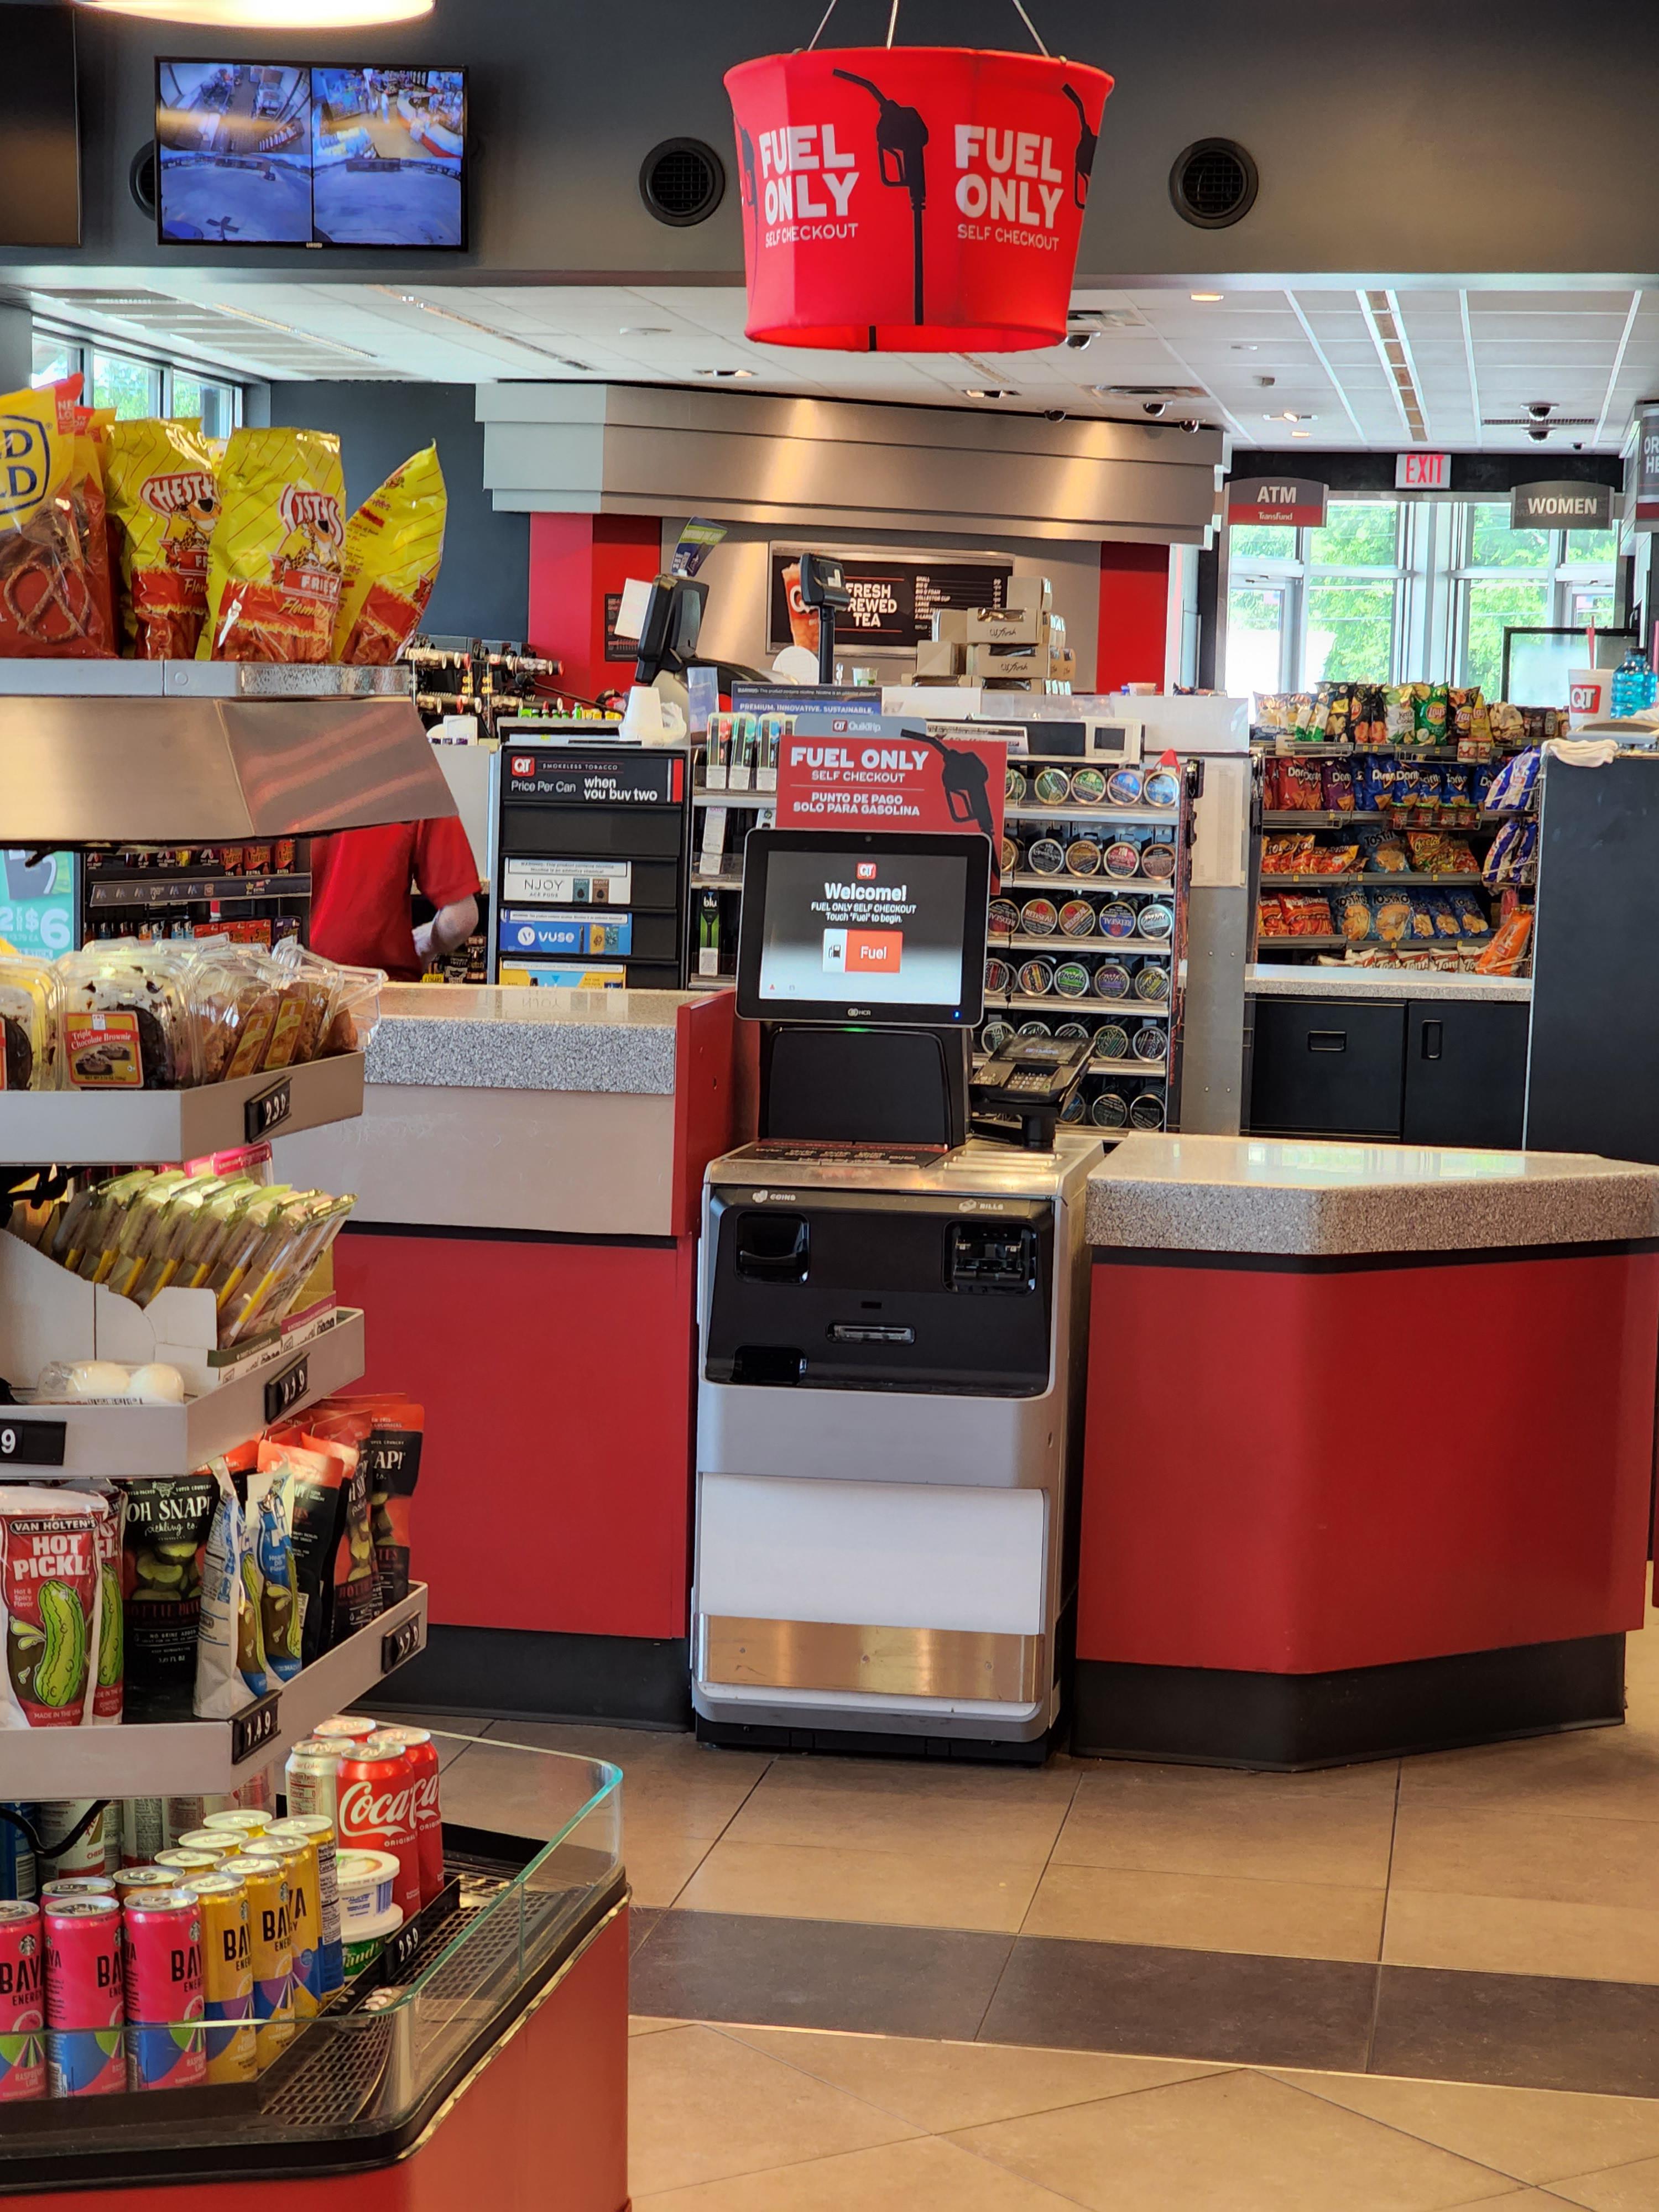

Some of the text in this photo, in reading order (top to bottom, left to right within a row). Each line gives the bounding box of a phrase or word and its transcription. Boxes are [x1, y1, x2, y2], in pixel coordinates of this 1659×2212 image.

[759, 124, 855, 179] FUEL
[954, 124, 1062, 184] FUEL
[764, 172, 859, 226] ONLY
[956, 174, 1064, 229] ONLY
[765, 223, 859, 249] SELF CHECKOUT
[957, 224, 1060, 252] SELF CHECKOUT
[1406, 455, 1445, 485] EXIT
[1257, 486, 1297, 504] ATM
[1528, 498, 1598, 515] WOMEN
[1258, 511, 1293, 521] TransFund
[301, 575, 338, 594] FRIES
[846, 583, 891, 598] FRESH
[847, 598, 897, 613] REWED
[853, 613, 881, 627] TEA
[1571, 687, 1595, 709] QT
[833, 721, 846, 731] QT
[514, 758, 531, 773] QT
[791, 747, 929, 770] FUEL ONLY
[584, 775, 616, 789] when
[811, 770, 905, 783] SELF CHECKOUT
[511, 780, 576, 792] Price Per Can
[584, 787, 658, 801] you buy two
[811, 792, 903, 805] PUNTO DE PAGO
[793, 802, 920, 816] SOLO PARA GASOLINA
[859, 864, 874, 877] QT
[525, 880, 563, 891] NJOY
[824, 882, 907, 902] Welcome!
[704, 895, 718, 907] blu
[811, 901, 917, 914] FUEL ONLY SELF CHECKOUT
[0, 906, 13, 931] 2
[826, 911, 848, 921] Touch
[872, 913, 879, 922] to
[880, 913, 903, 925] begin.
[860, 945, 887, 960] Fuel
[1058, 972, 1086, 983] SKOAL
[71, 1032, 132, 1050] Chocolate Brownie
[72, 1029, 91, 1040] Triple
[1, 1428, 16, 1454] 9
[126, 1495, 210, 1522] OH SNAP!
[14, 1519, 96, 1531] VAN HOLTEN'S
[144, 1521, 197, 1536] pickling co.
[32, 1535, 82, 1556] HOT
[419, 1820, 441, 1831] ORIGIN
